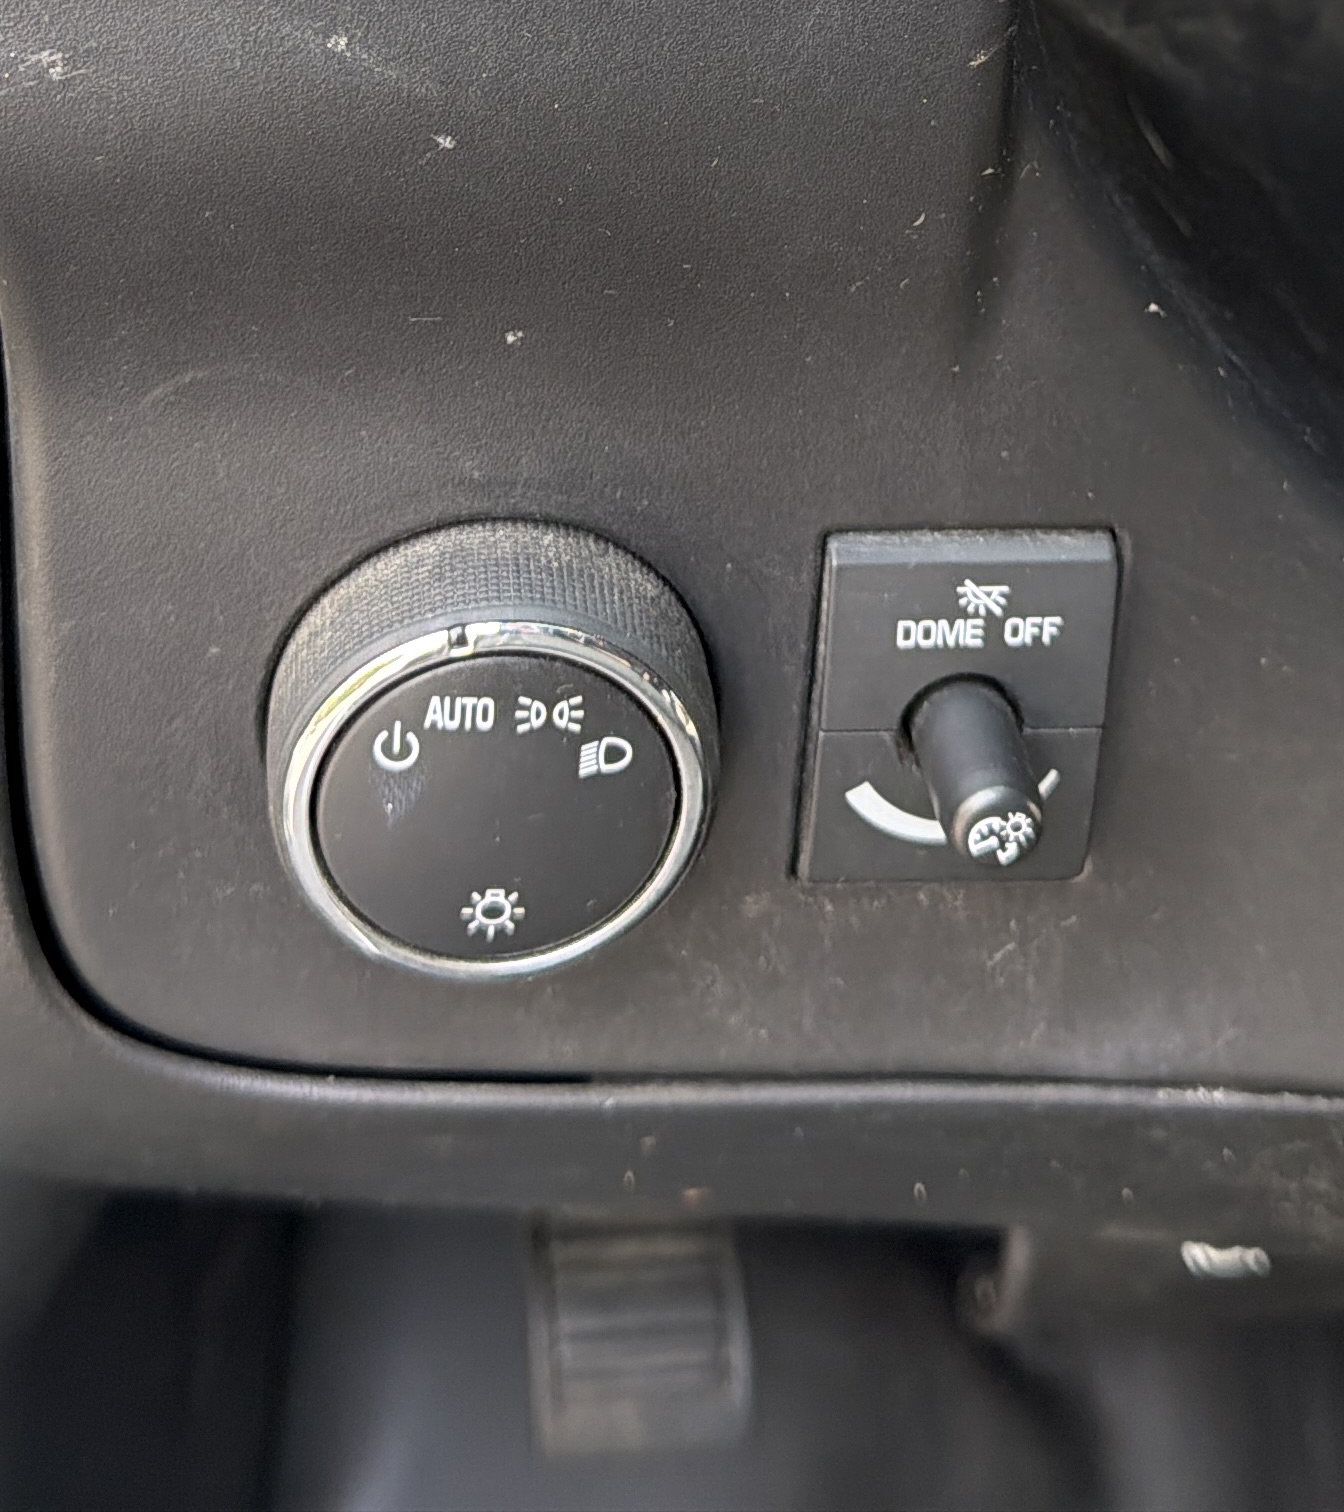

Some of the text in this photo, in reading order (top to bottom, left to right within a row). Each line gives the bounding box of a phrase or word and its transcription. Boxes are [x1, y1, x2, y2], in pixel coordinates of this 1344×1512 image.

[896, 615, 1064, 650] DOME OFF
[423, 694, 496, 732] AUTO
